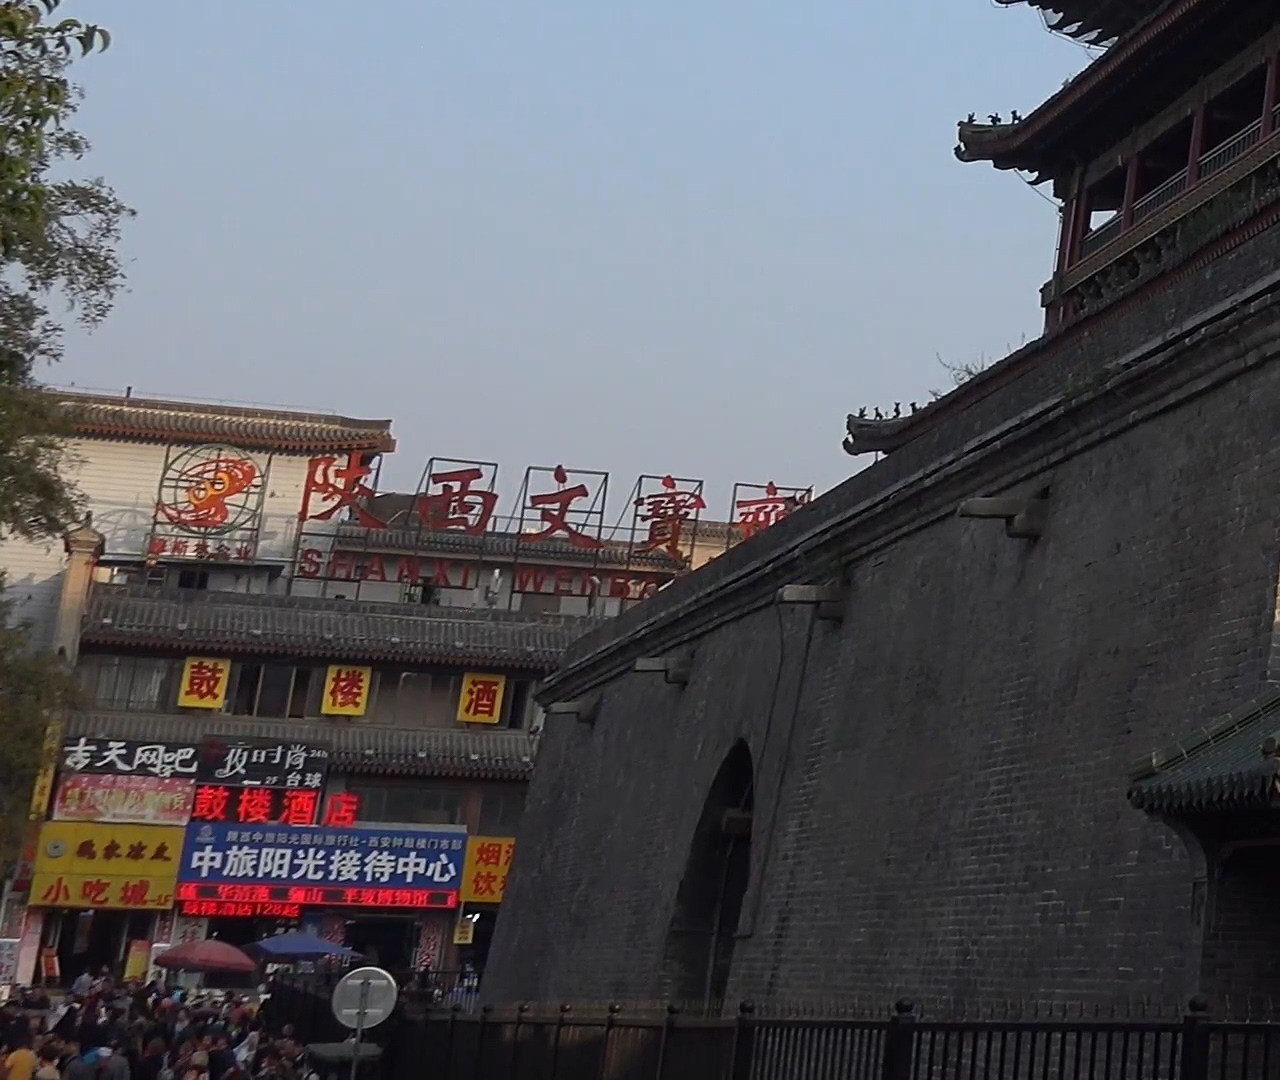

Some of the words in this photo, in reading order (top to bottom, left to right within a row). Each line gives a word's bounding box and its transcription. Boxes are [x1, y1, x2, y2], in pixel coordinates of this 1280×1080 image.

[286, 772, 322, 788] 台球
[193, 785, 360, 827] 鼓楼酒店
[190, 845, 457, 883] 中旅阳光接待中心
